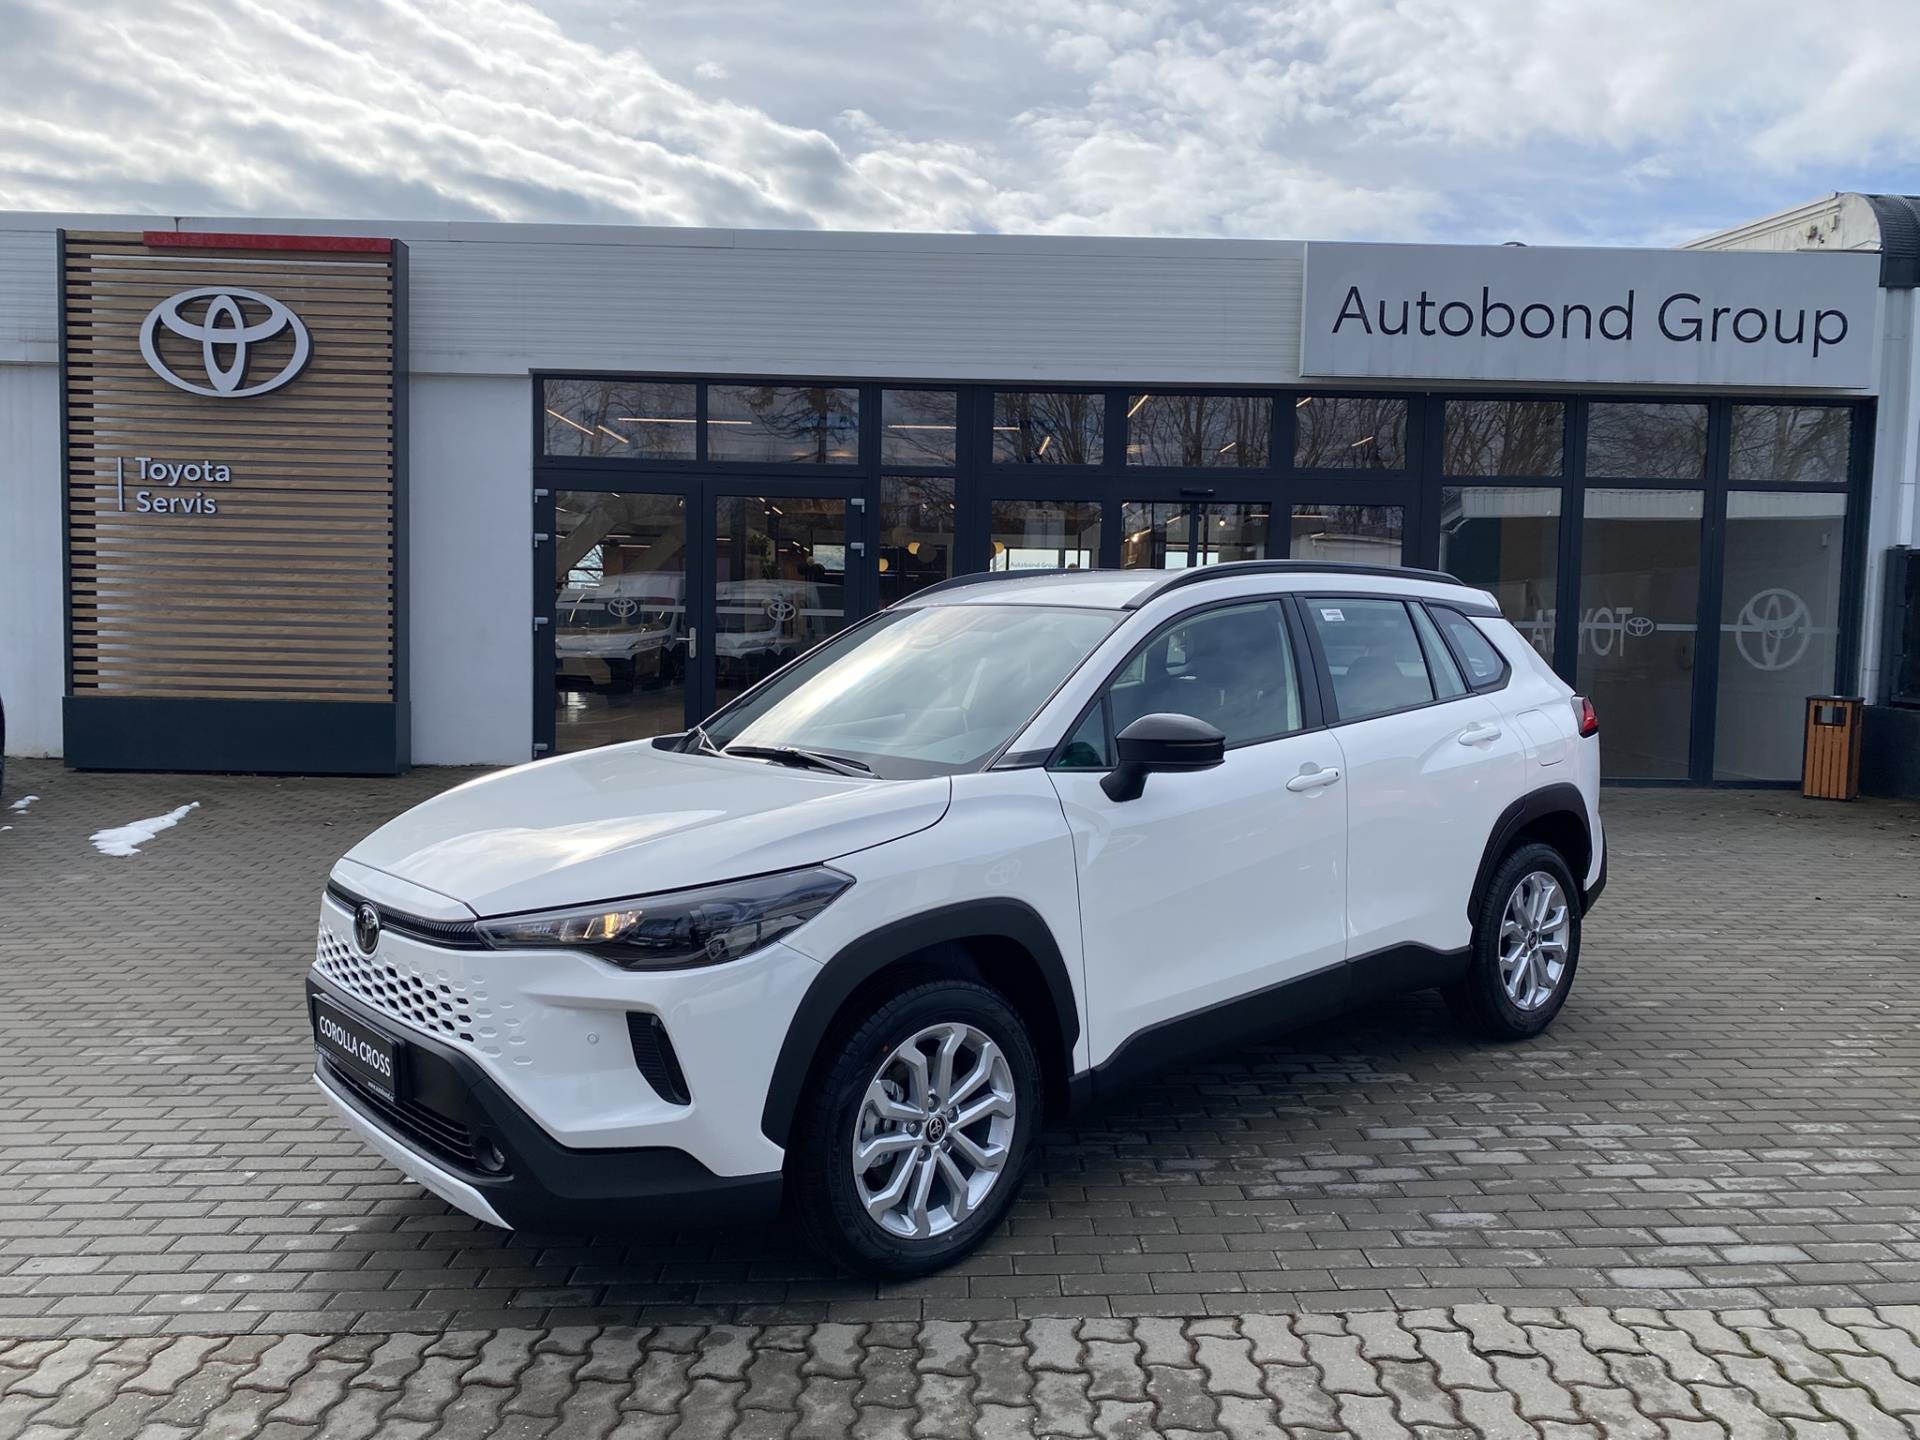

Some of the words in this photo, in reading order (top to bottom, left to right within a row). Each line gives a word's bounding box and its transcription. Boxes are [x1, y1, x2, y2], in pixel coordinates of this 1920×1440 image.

[1332, 286, 1635, 341] Autobond
[1657, 293, 1849, 358] Group
[135, 457, 231, 487] Toyota
[136, 490, 217, 514] Servis
[319, 1015, 359, 1057] COROLLA
[359, 1041, 391, 1077] CROSS
